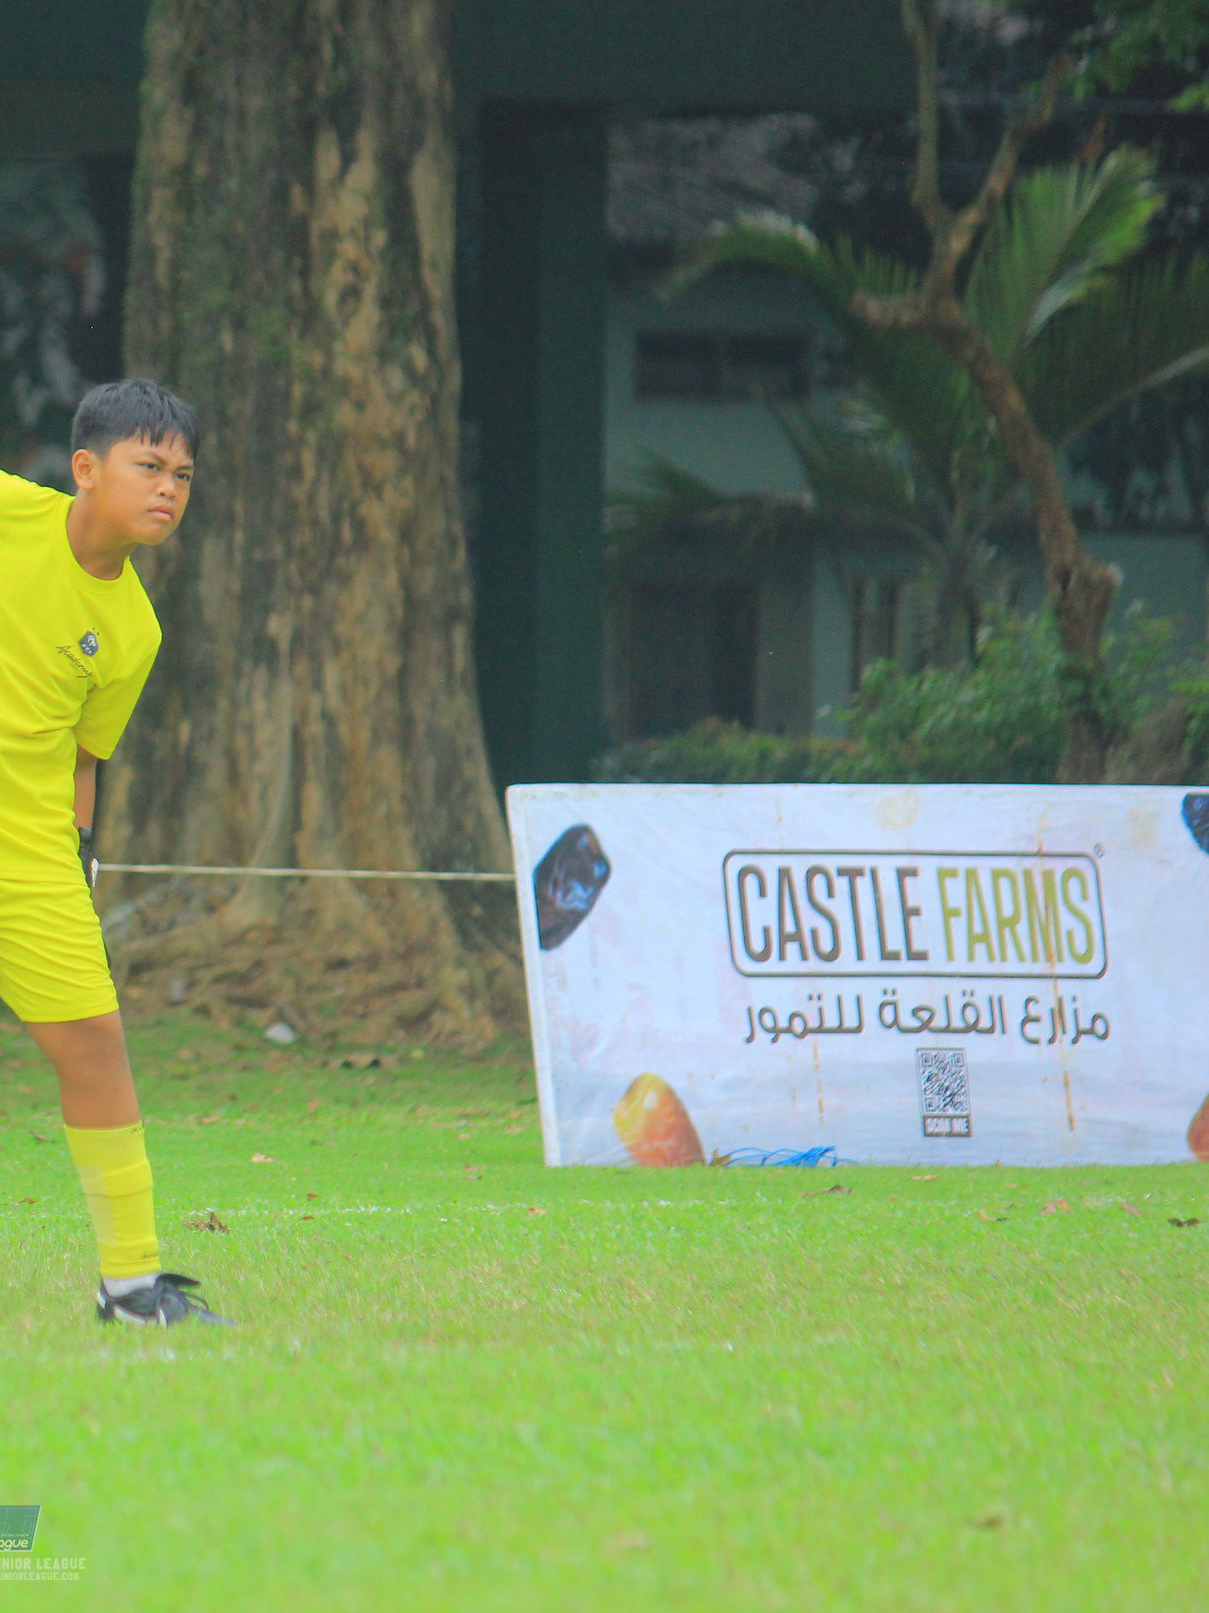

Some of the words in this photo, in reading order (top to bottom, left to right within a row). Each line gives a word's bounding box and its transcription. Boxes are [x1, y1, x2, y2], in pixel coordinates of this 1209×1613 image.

[738, 864, 929, 962] CASTLE
[937, 867, 1095, 964] FARMS
[745, 993, 865, 1044] للتمور
[878, 988, 1009, 1035] القلعة
[1021, 994, 1111, 1044] مزارع
